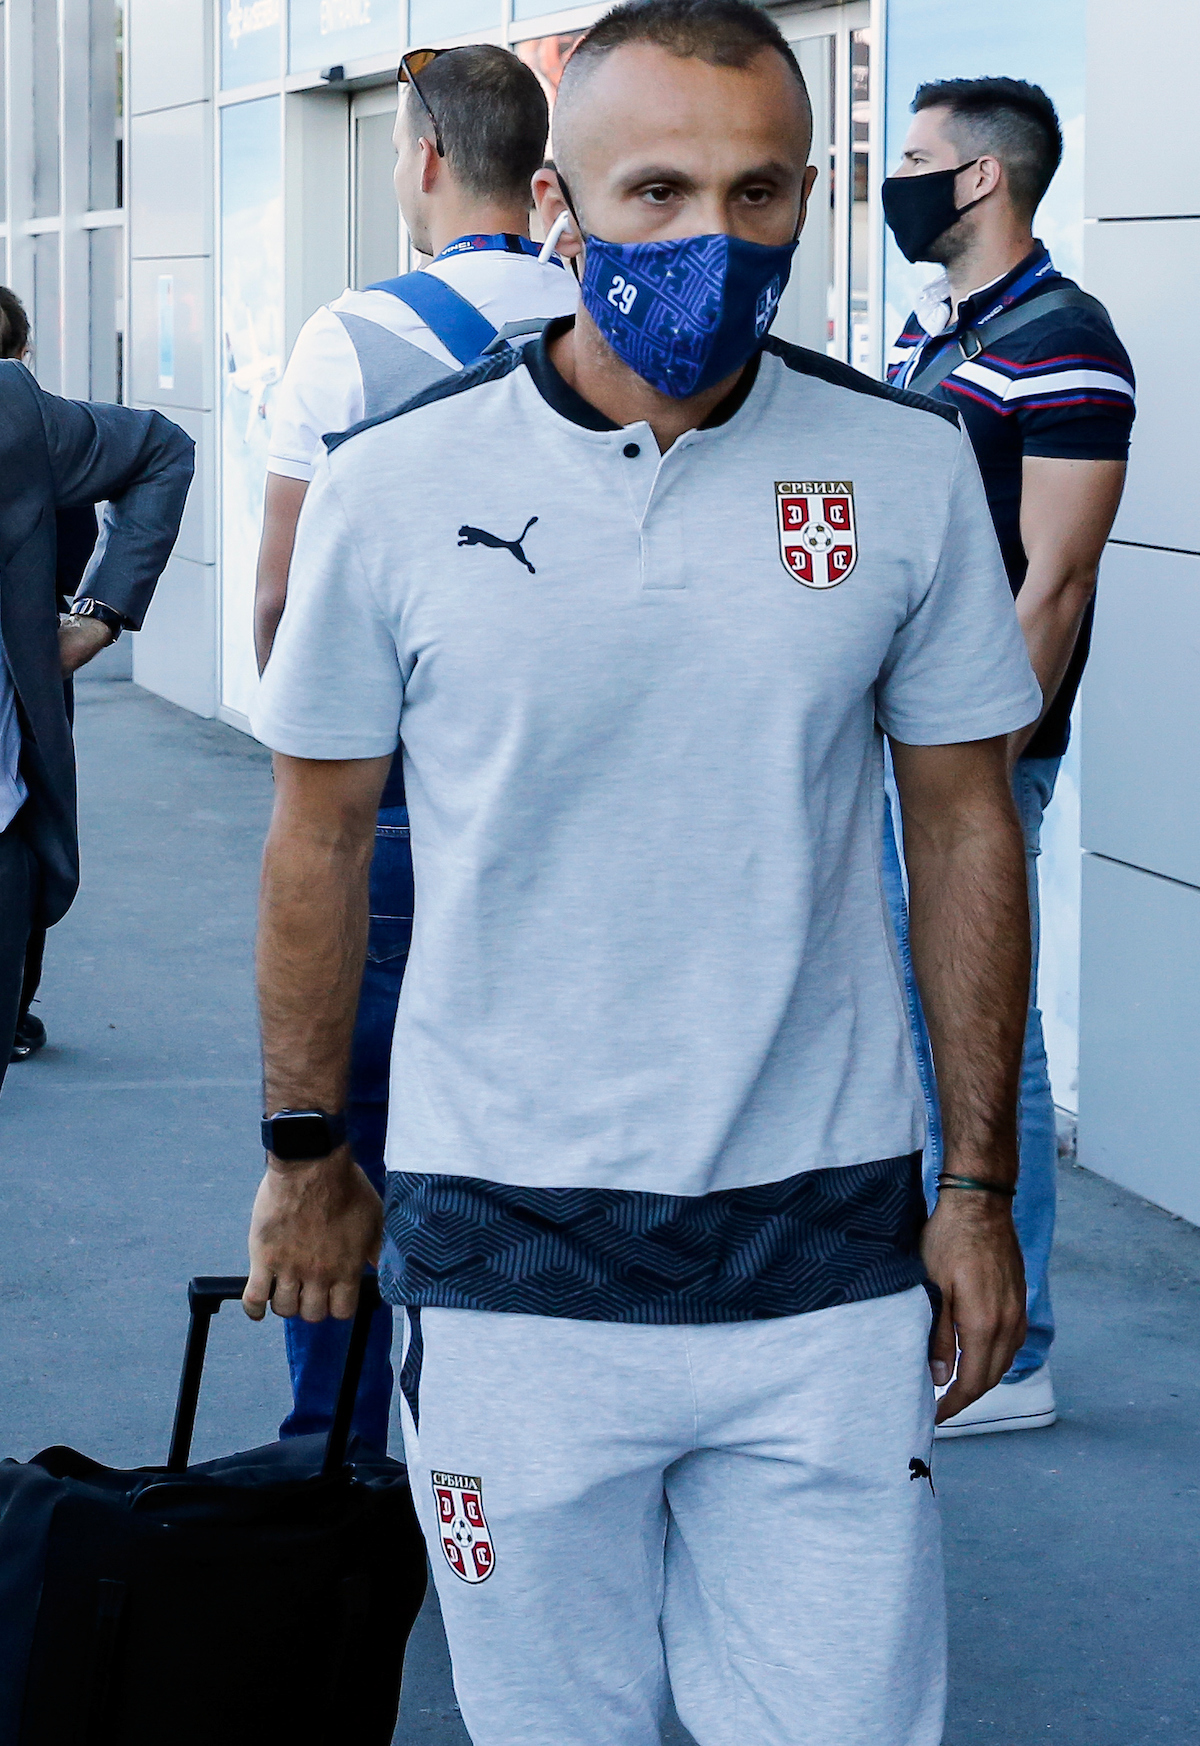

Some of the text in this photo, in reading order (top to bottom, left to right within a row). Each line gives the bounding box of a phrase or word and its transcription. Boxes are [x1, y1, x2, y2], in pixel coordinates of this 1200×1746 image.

[607, 274, 638, 316] 29
[777, 482, 850, 494] СРБИЈА
[432, 1472, 479, 1490] СРБИЈА
